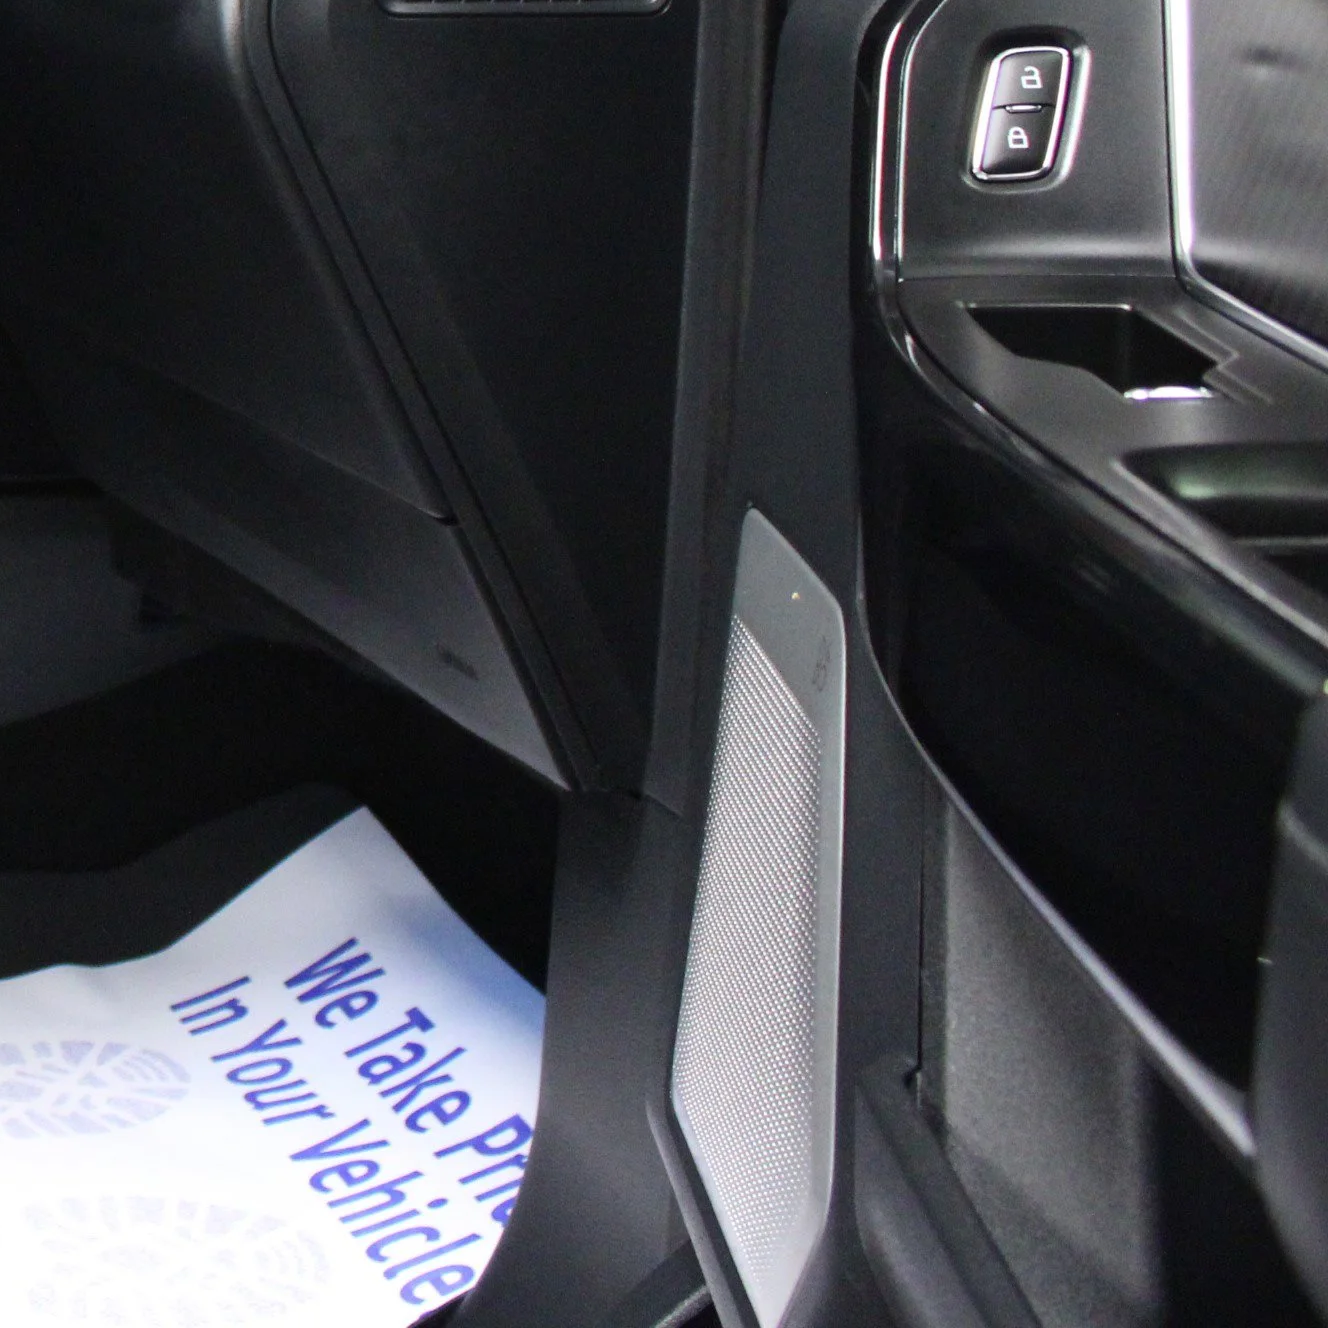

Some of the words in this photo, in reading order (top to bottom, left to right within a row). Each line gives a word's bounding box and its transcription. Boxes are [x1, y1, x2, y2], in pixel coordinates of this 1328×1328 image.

[170, 975, 252, 1036] In
[210, 1018, 335, 1126] Your
[283, 936, 387, 1029] We
[344, 1006, 471, 1134] Take
[289, 1118, 482, 1305] Vehicle
